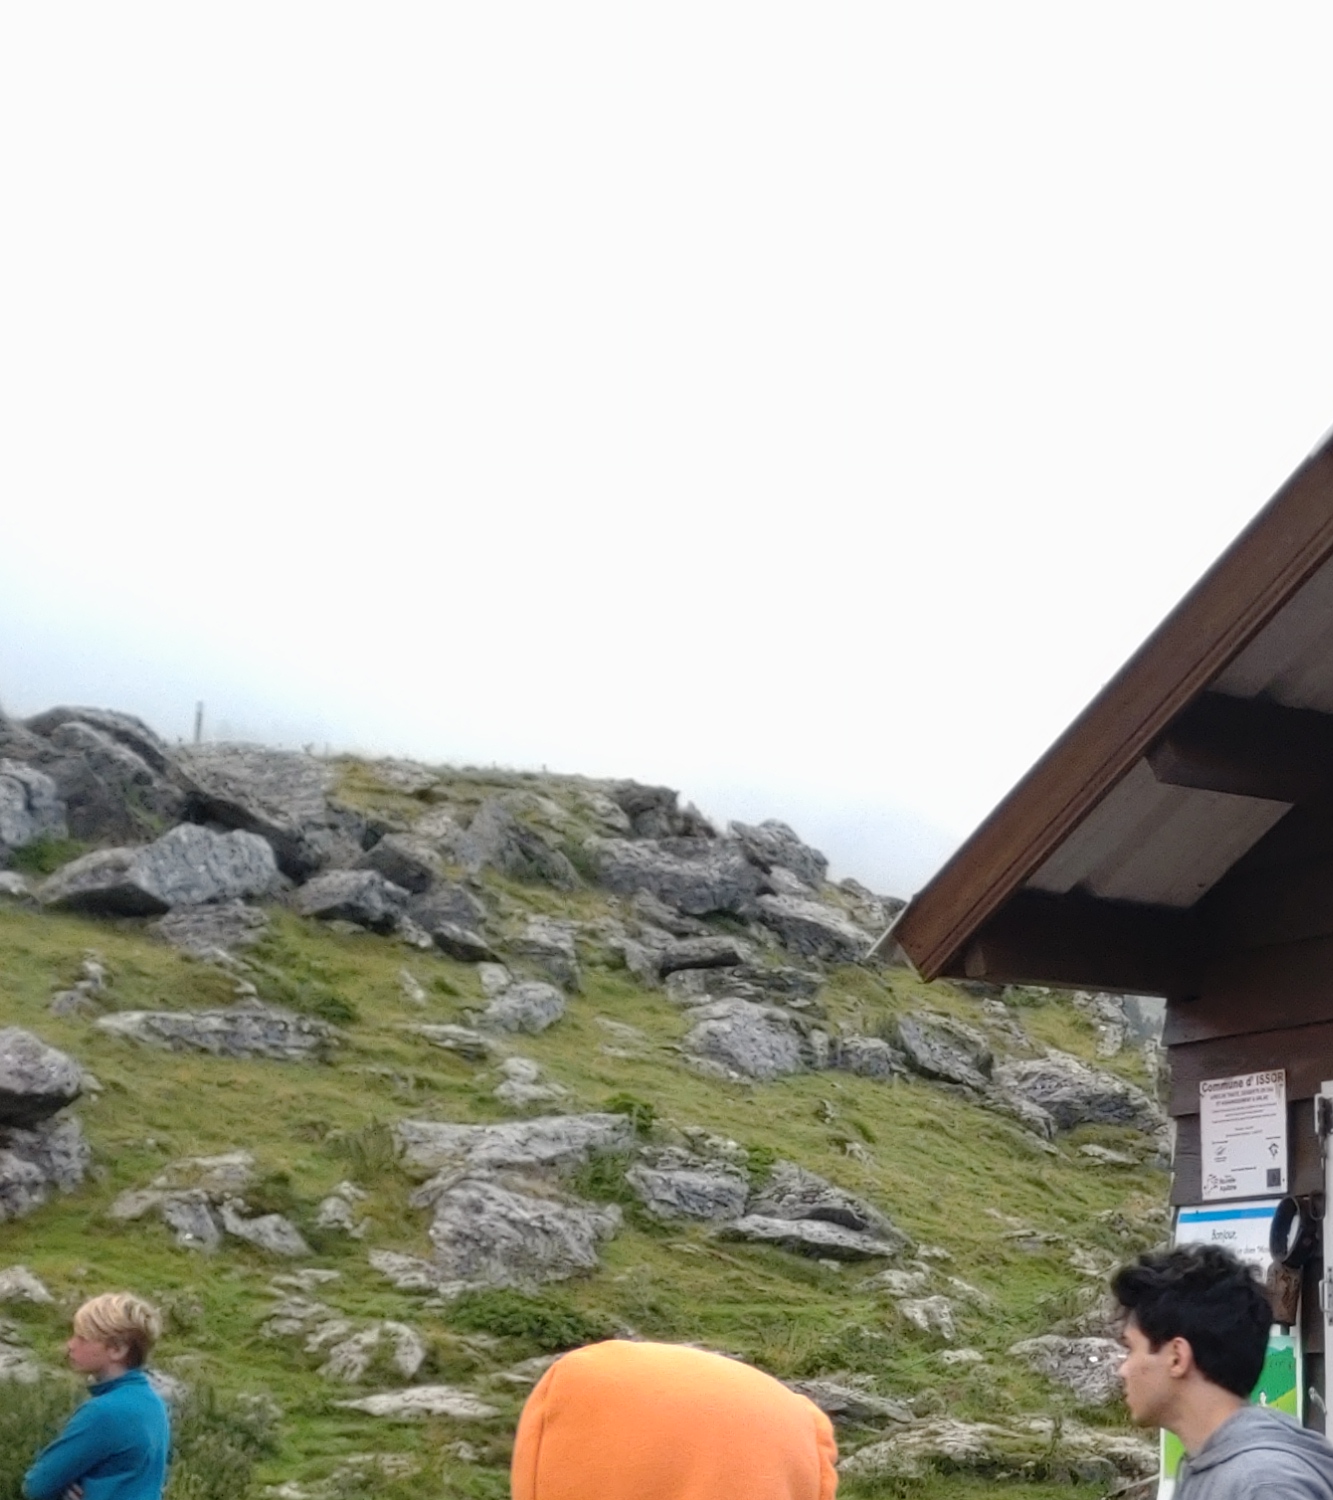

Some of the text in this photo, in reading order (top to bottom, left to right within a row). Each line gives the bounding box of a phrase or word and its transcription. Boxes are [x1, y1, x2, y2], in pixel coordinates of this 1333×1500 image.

[1202, 1079, 1244, 1093] Commune
[1256, 1071, 1284, 1086] ISSOR
[1211, 1229, 1237, 1243] Bonjour,
